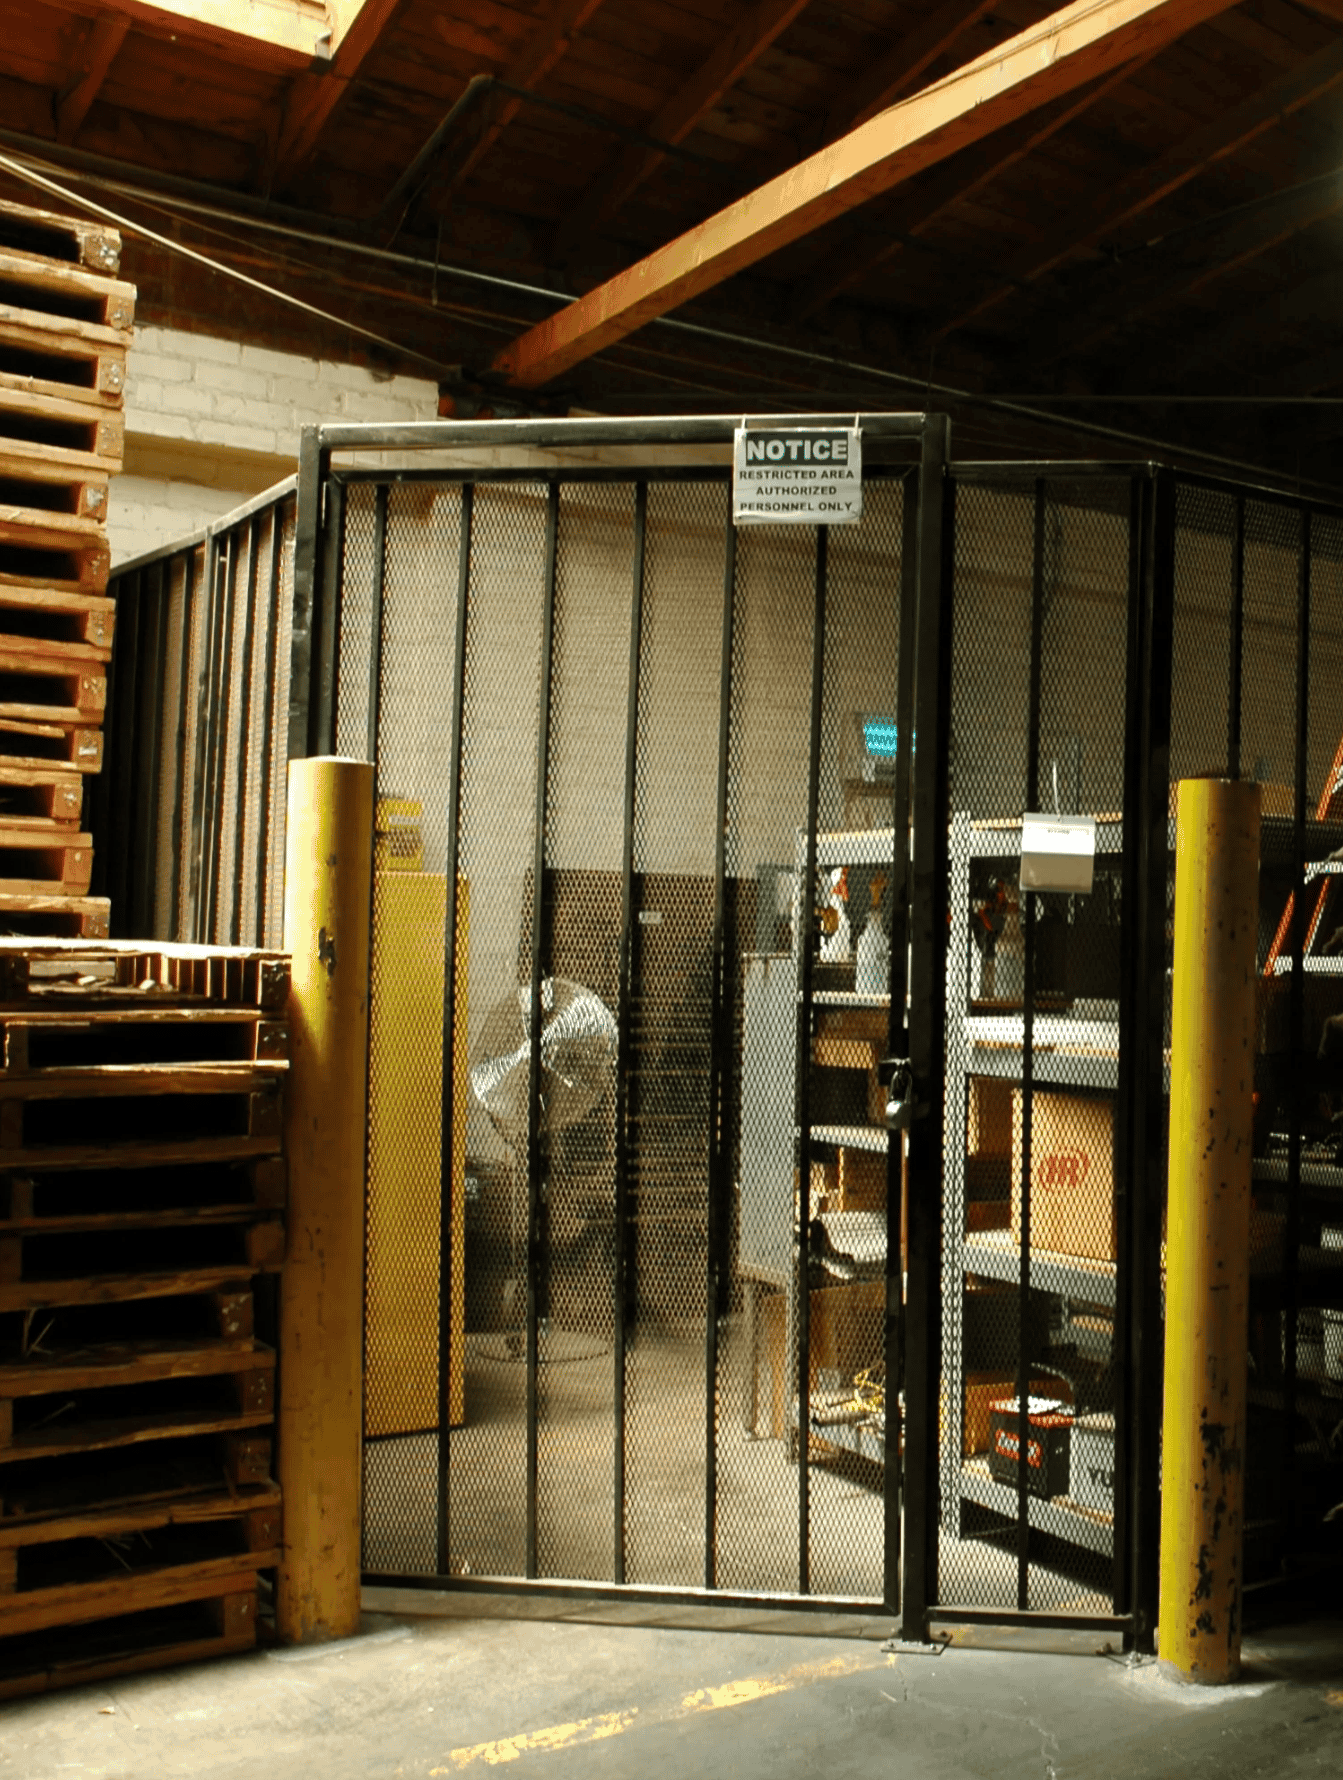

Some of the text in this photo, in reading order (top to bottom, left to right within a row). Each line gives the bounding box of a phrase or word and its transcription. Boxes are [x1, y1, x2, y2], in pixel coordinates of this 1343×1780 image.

[747, 440, 849, 460] NOTICE
[739, 470, 855, 479] RESTRICTED AREA
[756, 486, 837, 496] AUTHORIZED
[740, 502, 853, 511] PERSONNEL ONLY
